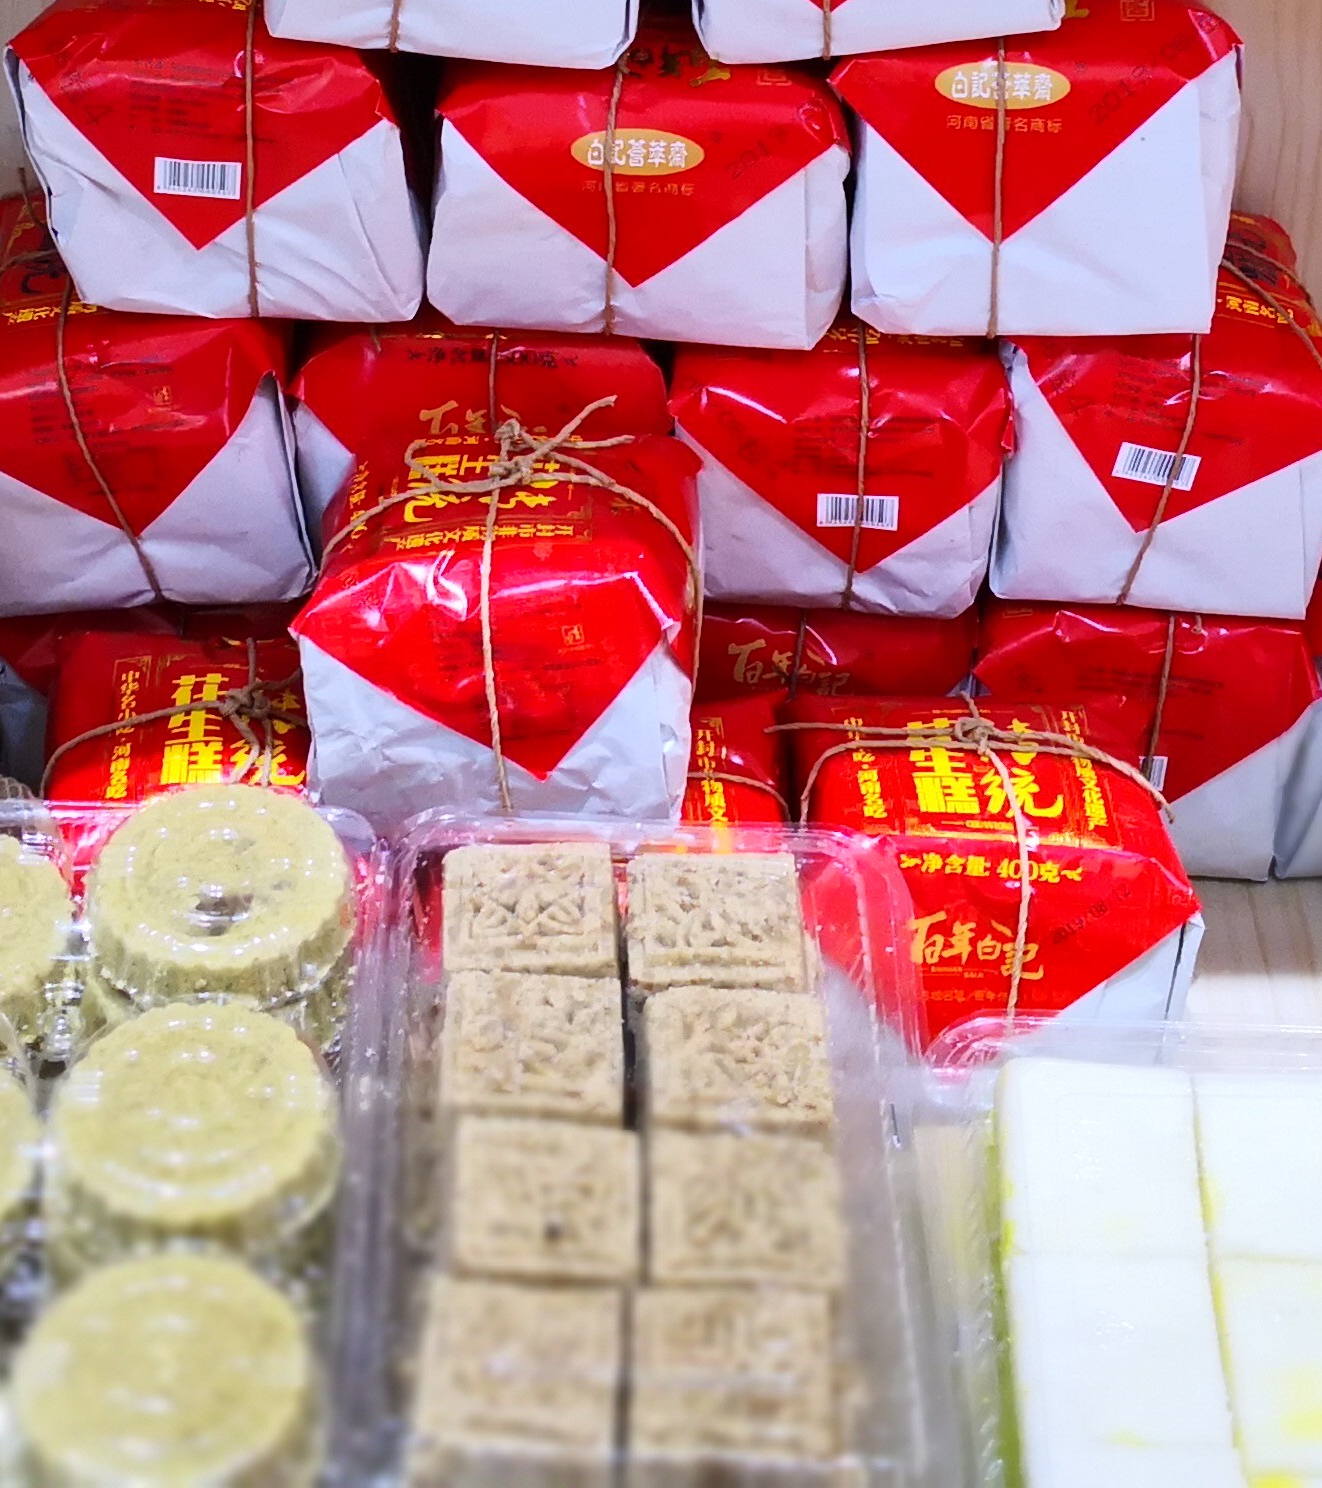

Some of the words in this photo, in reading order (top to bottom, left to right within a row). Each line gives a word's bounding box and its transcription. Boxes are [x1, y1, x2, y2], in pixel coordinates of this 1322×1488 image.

[581, 179, 696, 197] 河省著名商标
[161, 673, 229, 785] 花生糕
